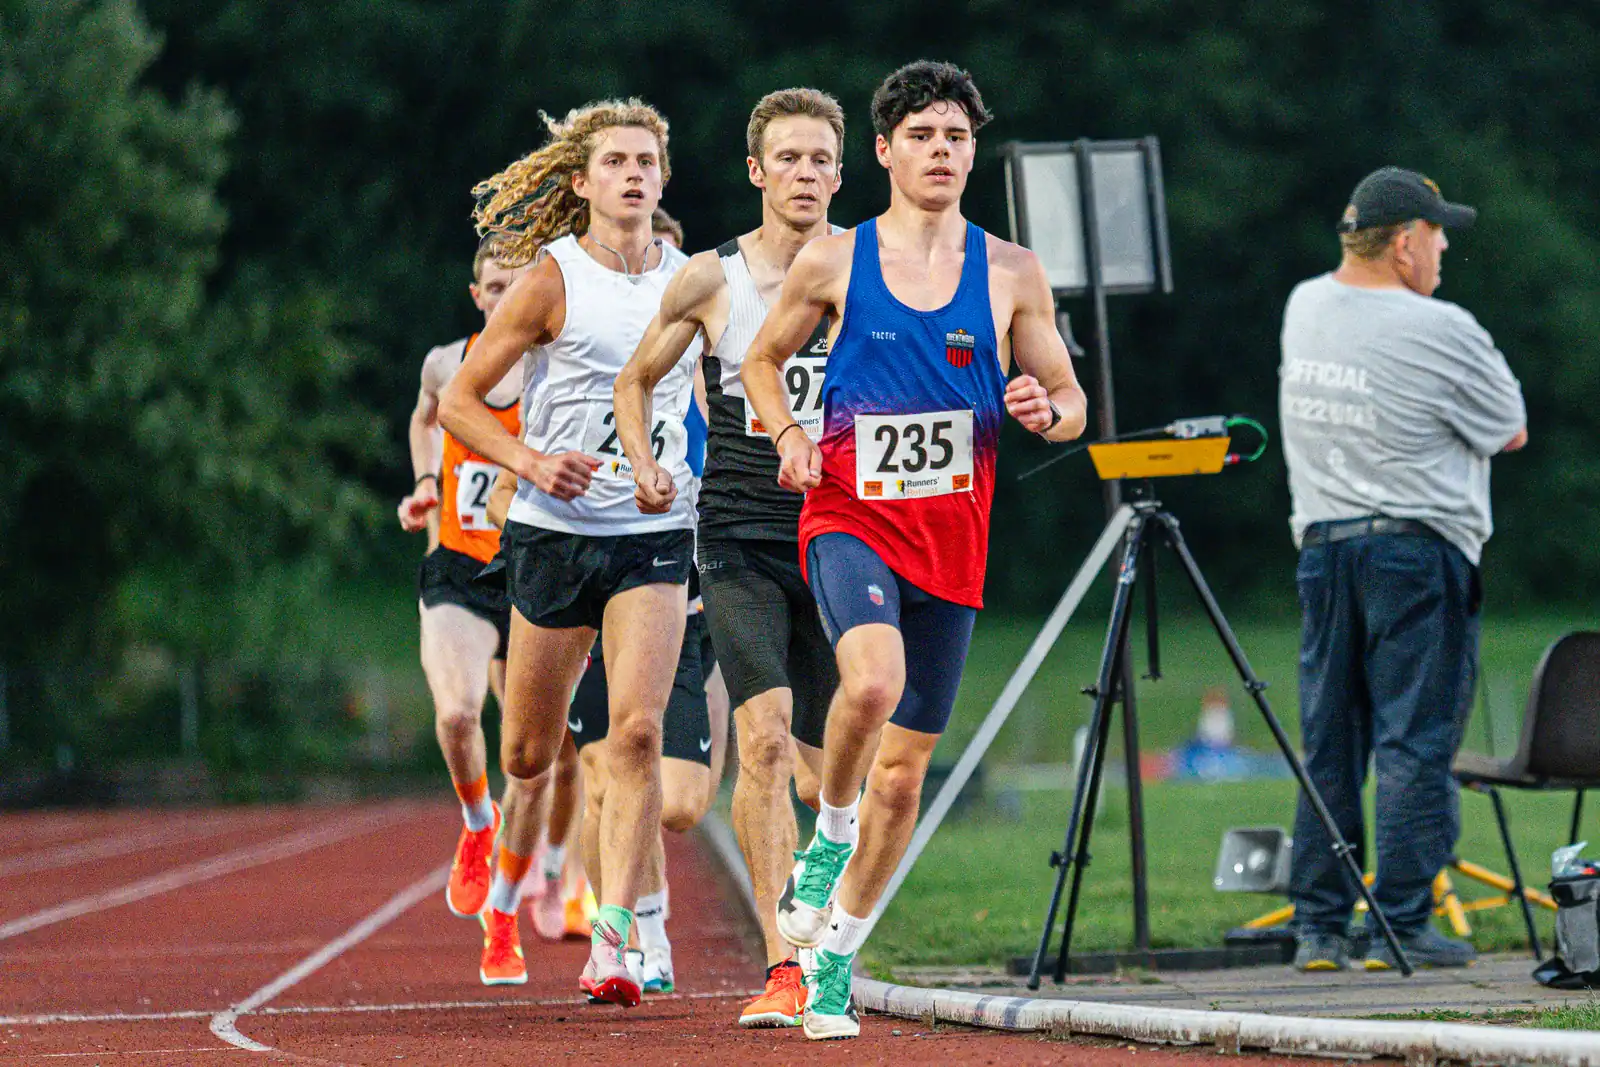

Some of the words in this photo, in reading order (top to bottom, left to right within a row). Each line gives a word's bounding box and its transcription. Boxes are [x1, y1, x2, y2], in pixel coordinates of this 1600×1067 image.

[871, 331, 896, 341] TACTIC
[596, 411, 666, 462] 26
[874, 420, 954, 473] 235
[906, 476, 940, 488] Runners'
